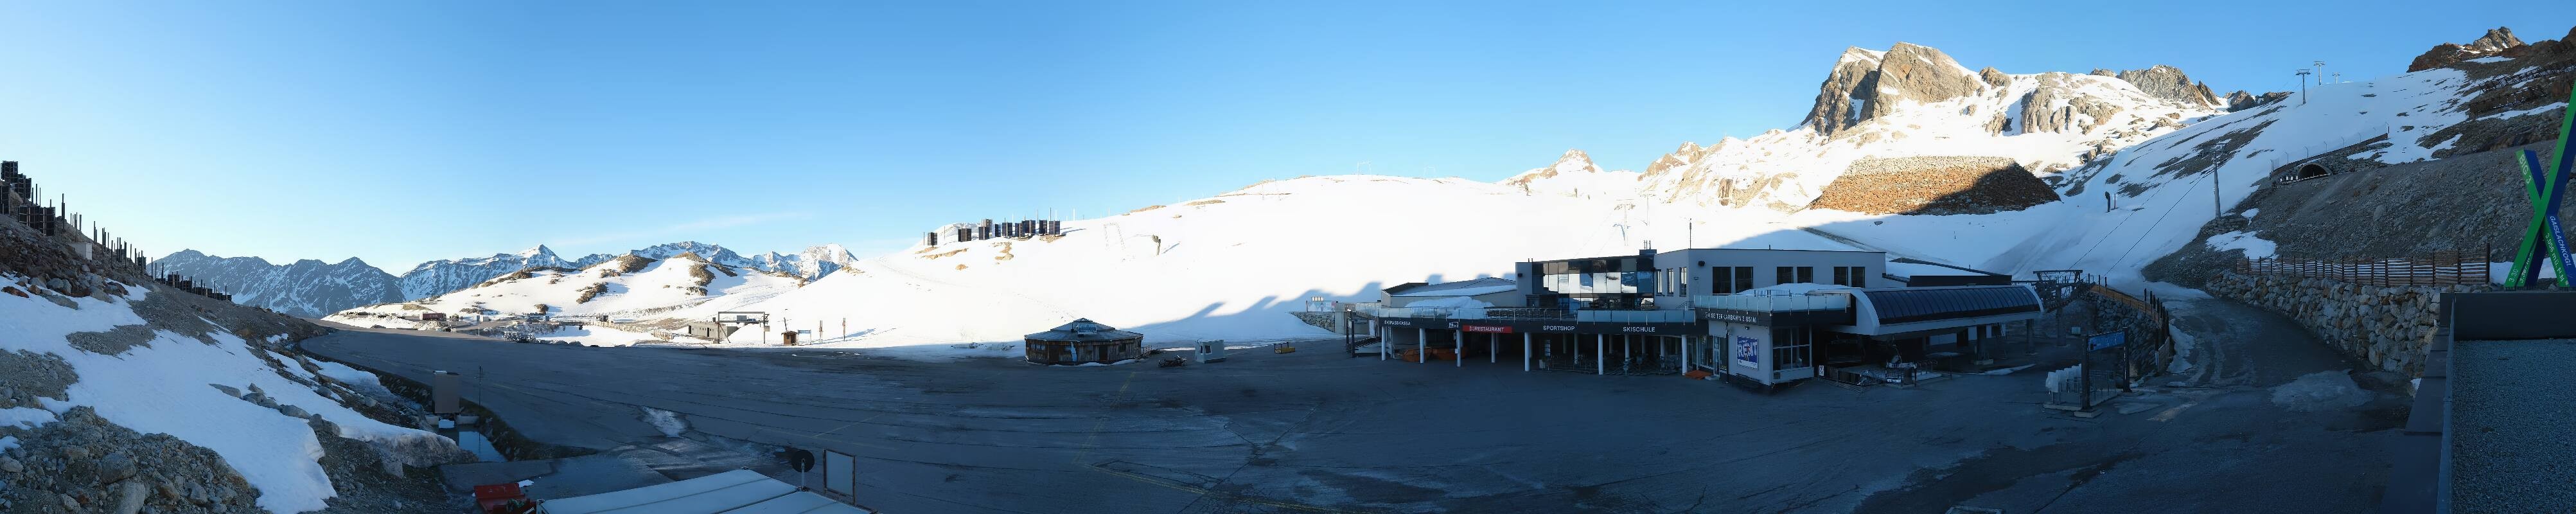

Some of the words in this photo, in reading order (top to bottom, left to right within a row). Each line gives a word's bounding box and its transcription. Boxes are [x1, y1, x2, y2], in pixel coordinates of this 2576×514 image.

[2519, 154, 2528, 175] BIG
[2527, 175, 2532, 184] 3
[2550, 216, 2572, 267] GAISLACHKOGL
